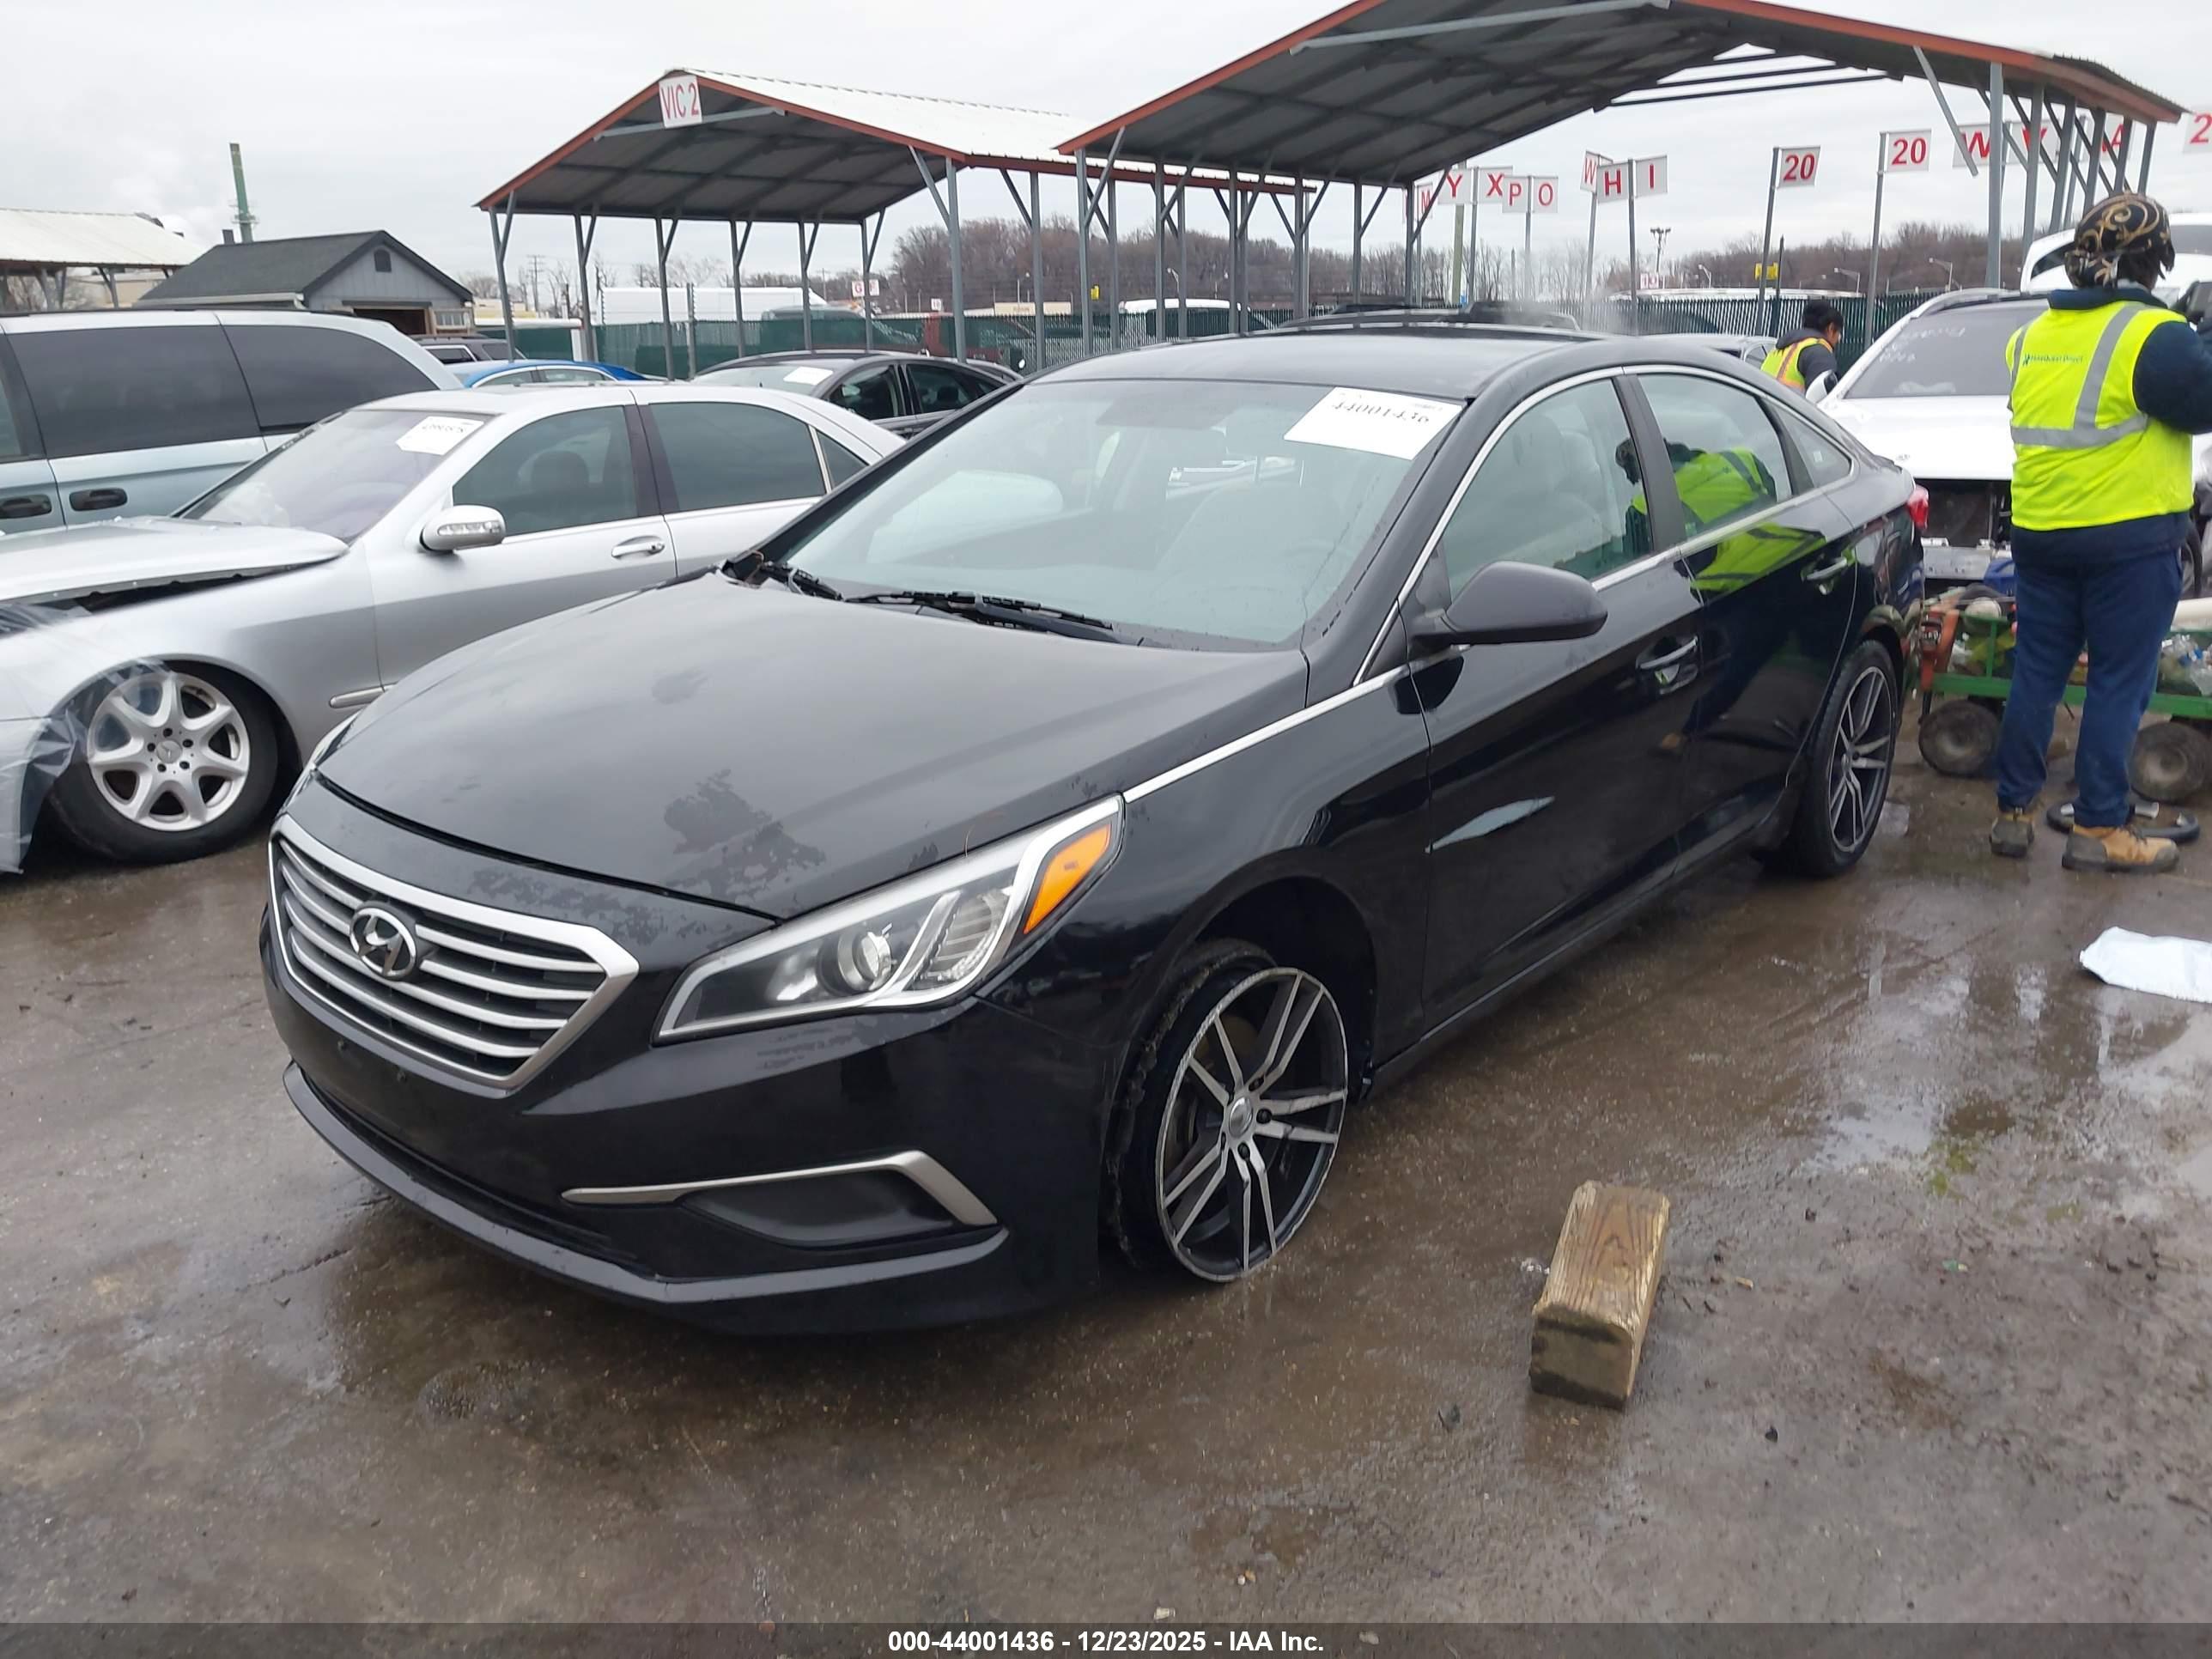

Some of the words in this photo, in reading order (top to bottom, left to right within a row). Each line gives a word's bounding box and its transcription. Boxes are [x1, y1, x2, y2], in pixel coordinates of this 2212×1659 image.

[661, 83, 686, 120] VIC
[688, 82, 700, 117] 2
[2189, 112, 2212, 144] 2
[1892, 137, 1927, 165] 20
[1584, 157, 1597, 185] W
[1784, 153, 1816, 182] 20
[1446, 173, 1463, 198] Y
[1486, 173, 1504, 198] X
[1509, 182, 1522, 207] P
[1603, 168, 1622, 198] H
